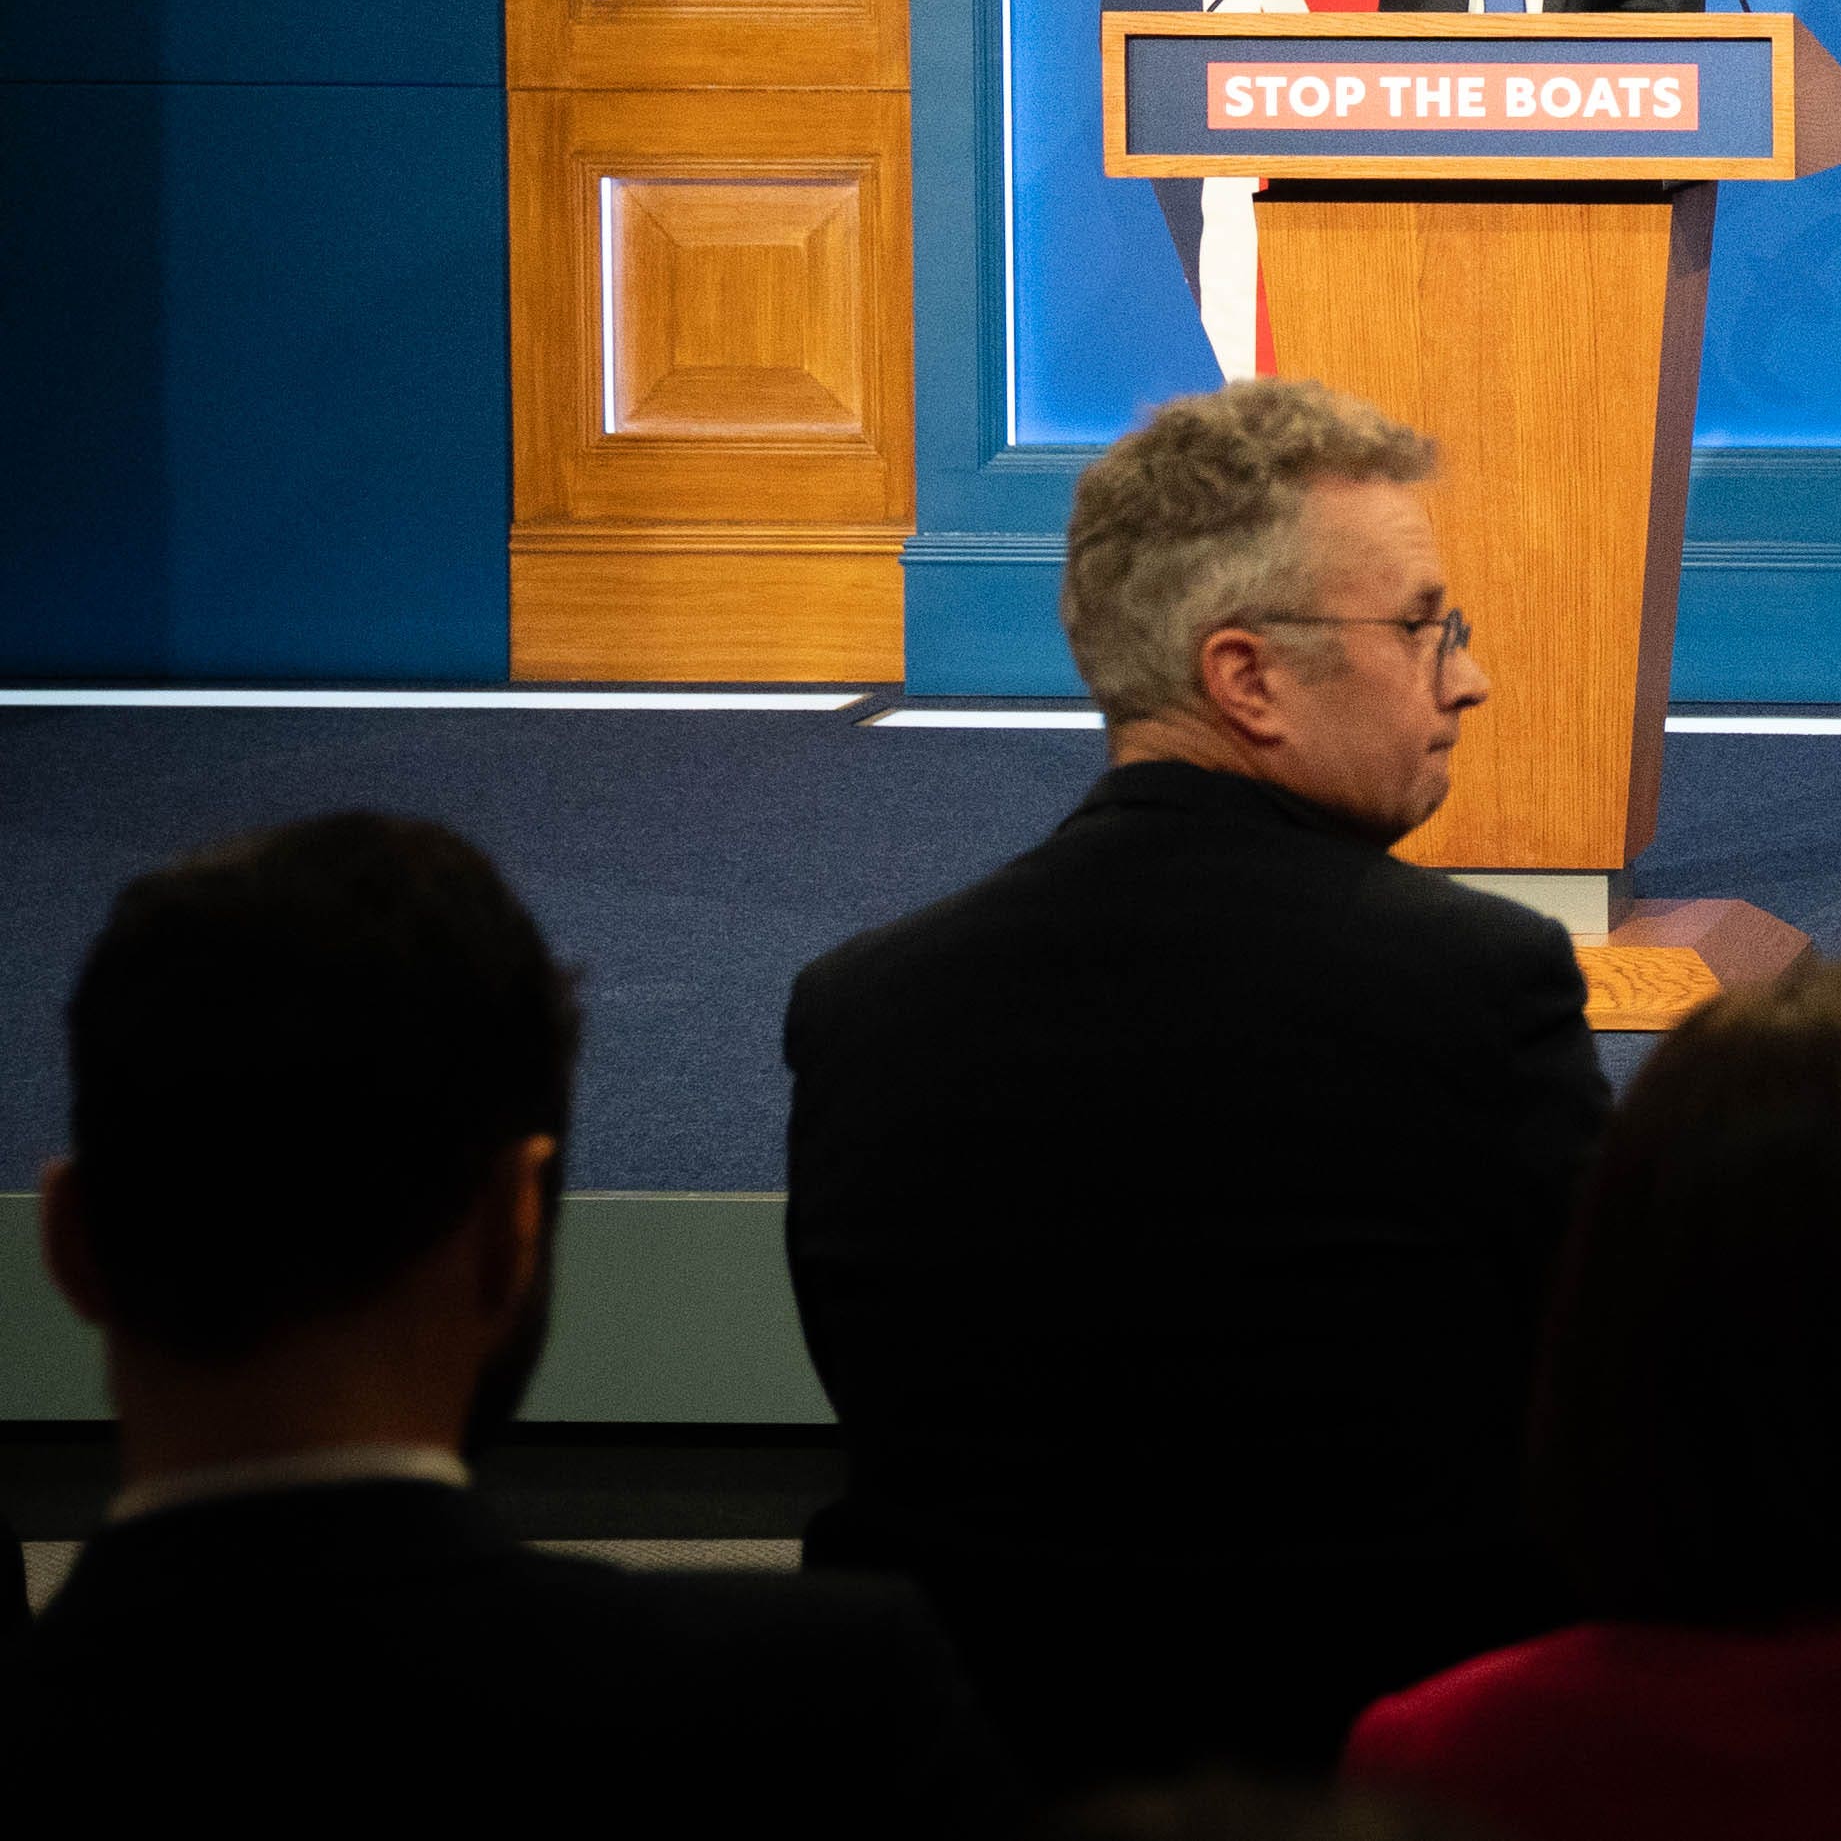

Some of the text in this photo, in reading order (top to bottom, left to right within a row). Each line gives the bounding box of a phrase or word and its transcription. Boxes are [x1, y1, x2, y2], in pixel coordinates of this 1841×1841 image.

[1224, 75, 1682, 119] STOP THE BOATS
